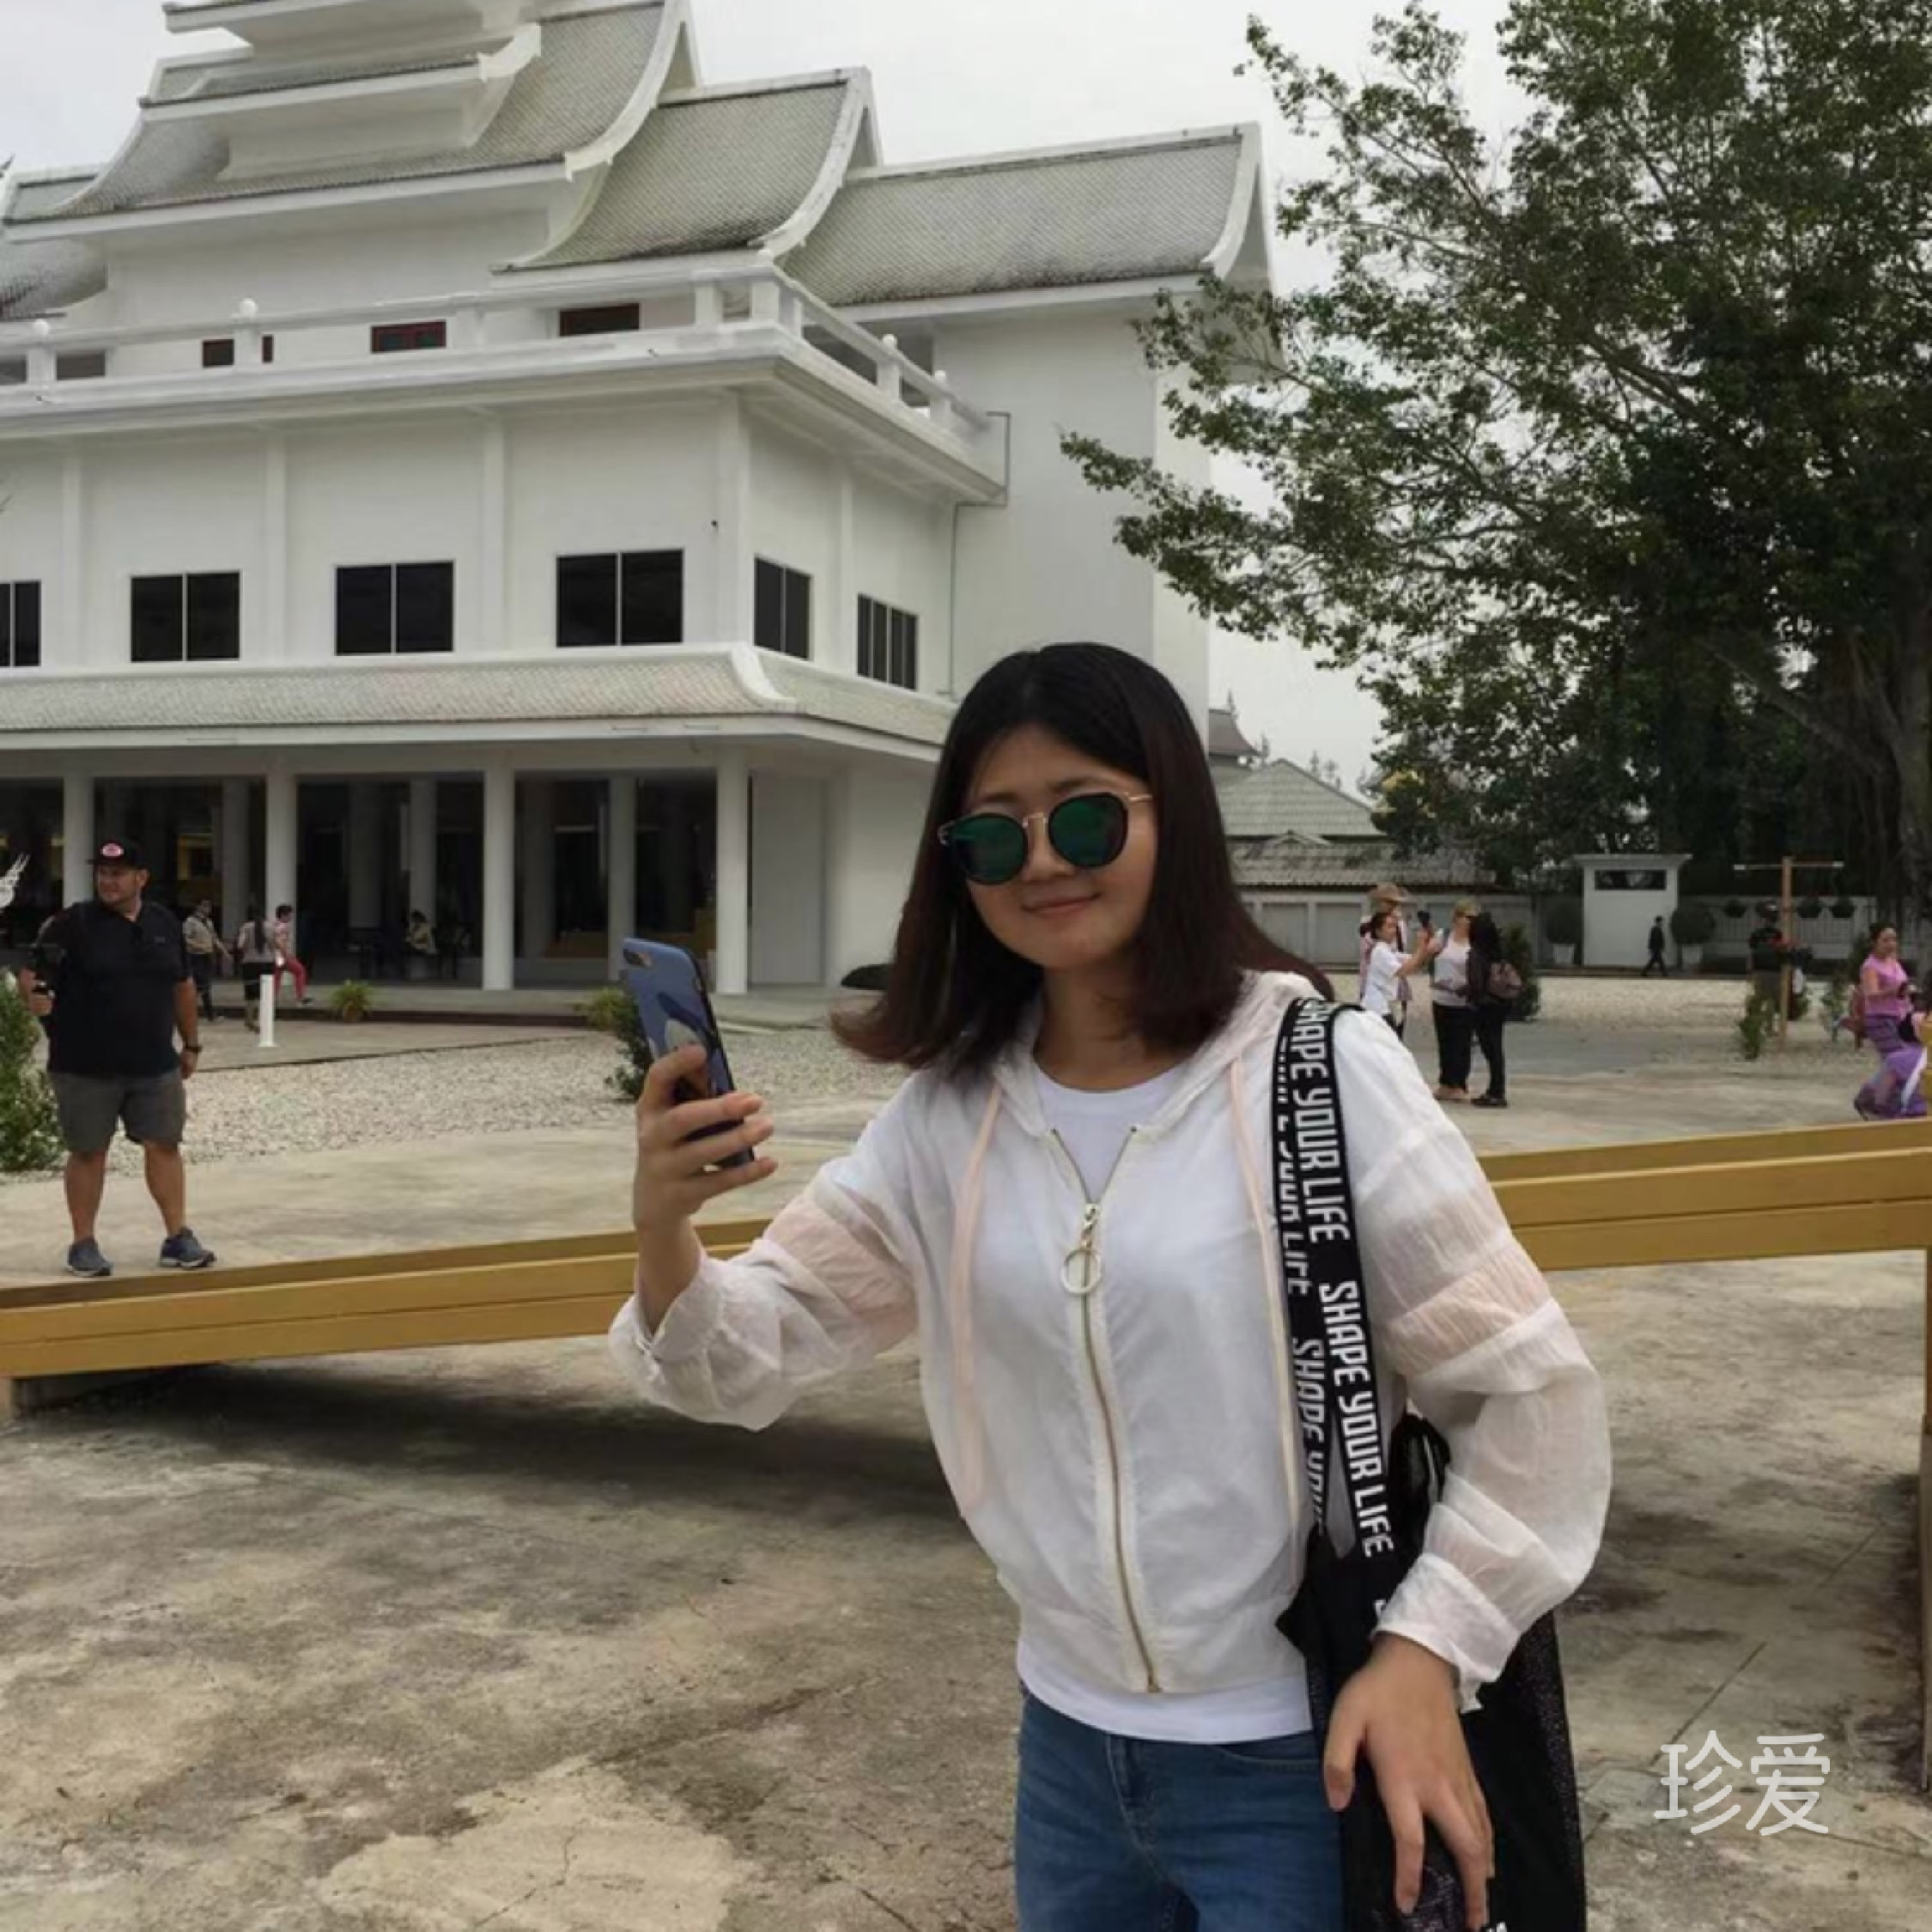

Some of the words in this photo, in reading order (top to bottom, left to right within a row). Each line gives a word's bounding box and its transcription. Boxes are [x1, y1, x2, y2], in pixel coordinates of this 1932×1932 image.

[1293, 1087, 1340, 1171] YOUR
[1302, 1177, 1351, 1243] LIFE
[1319, 1280, 1371, 1387] SHAPE
[1338, 1390, 1382, 1480] YOUR
[1355, 1484, 1394, 1558] LIFE
